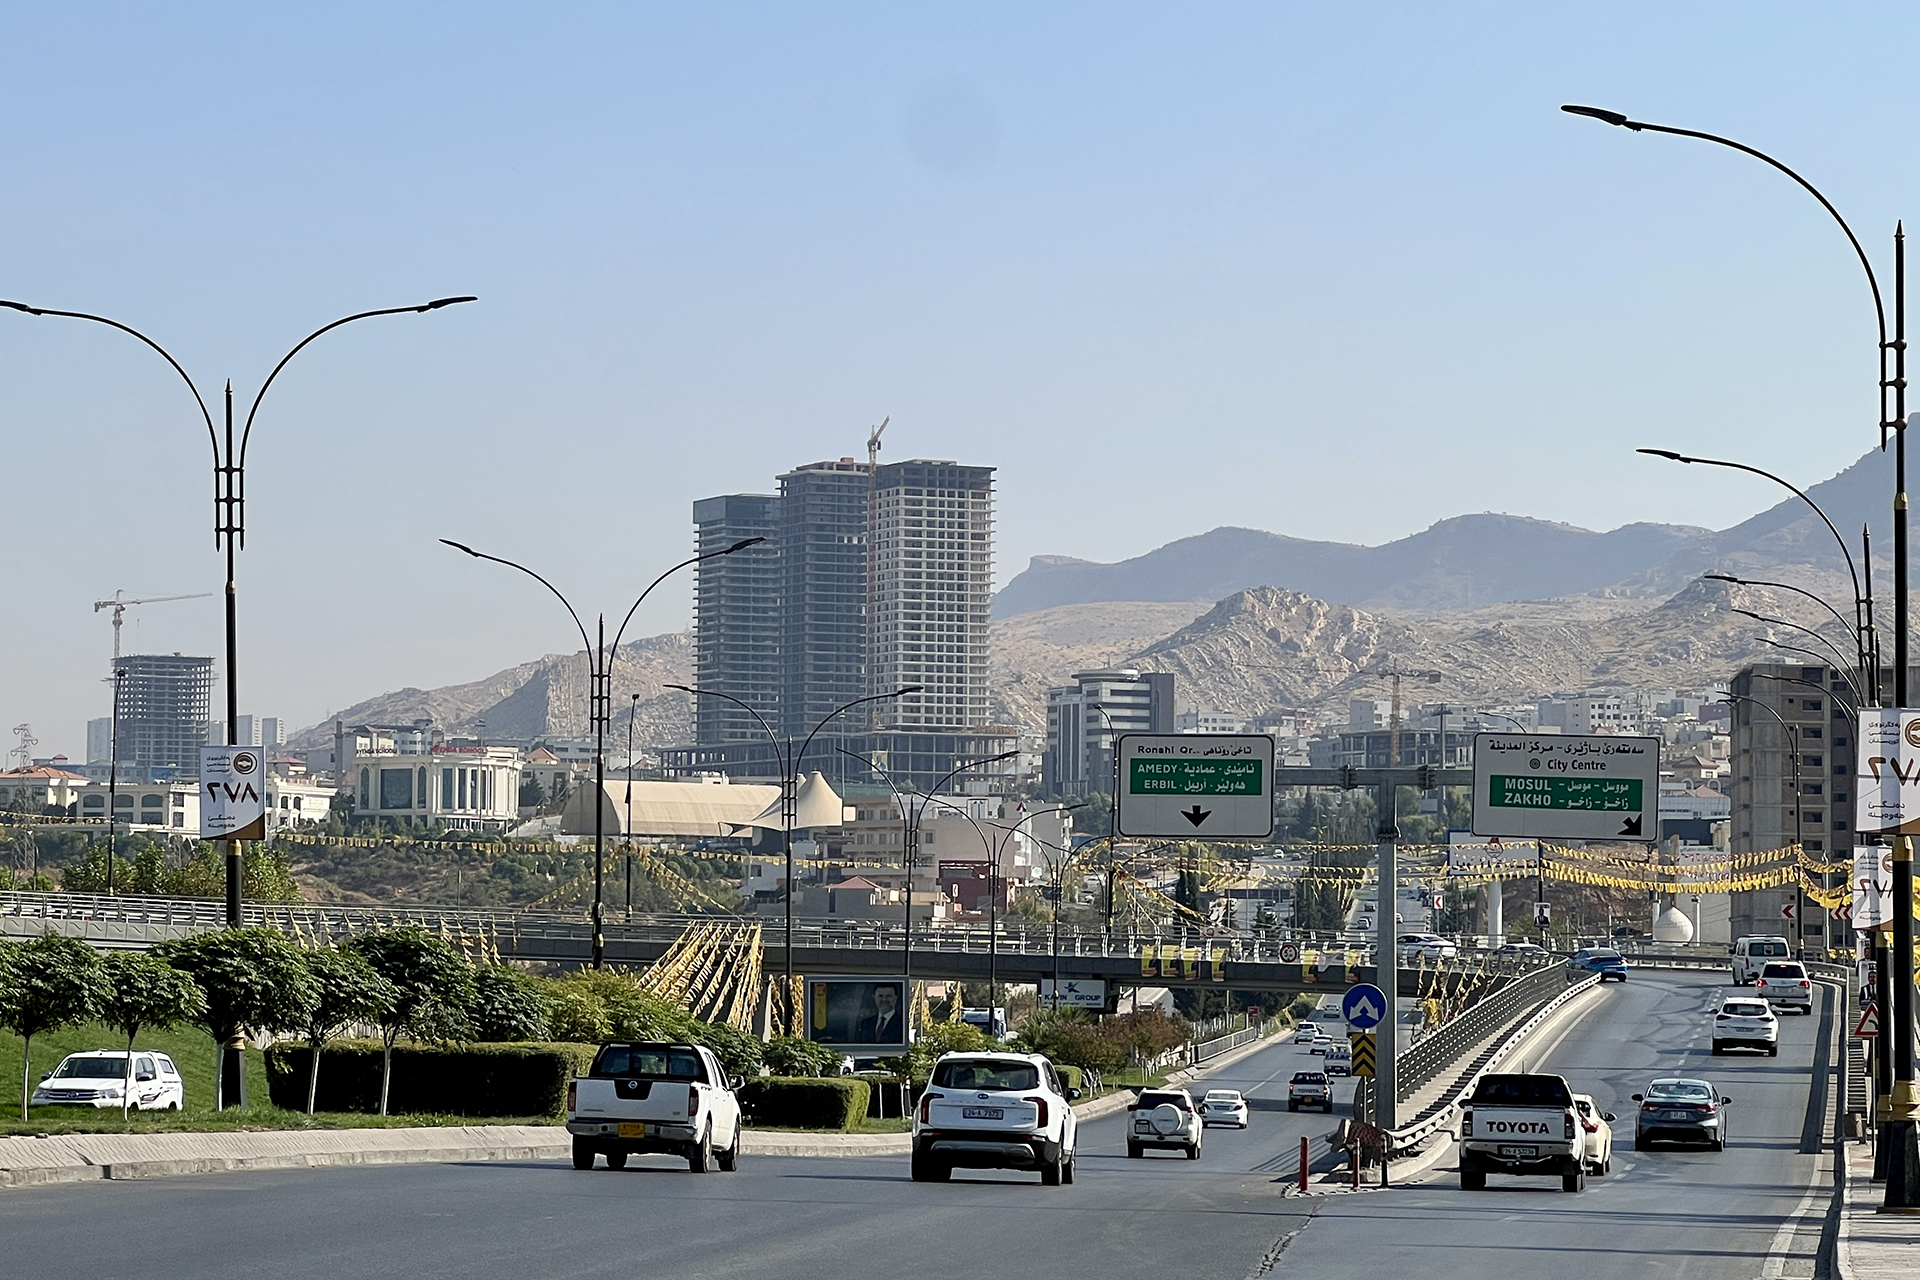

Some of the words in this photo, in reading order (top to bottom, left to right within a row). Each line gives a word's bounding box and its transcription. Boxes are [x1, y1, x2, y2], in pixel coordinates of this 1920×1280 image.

[1489, 739, 1526, 754] المدينة
[1528, 741, 1554, 755] مركز
[1137, 764, 1178, 773] AMEDY
[1183, 763, 1216, 777] عمادية
[1547, 759, 1568, 773] City
[1571, 760, 1606, 771] Centre
[1144, 780, 1177, 789] ERBIL
[1505, 778, 1552, 791] MOSUL
[1567, 780, 1592, 793] موصل
[1504, 793, 1552, 806] ZAKHO
[1566, 796, 1593, 810] زاخو
[1486, 1121, 1551, 1134] TOYOTA
